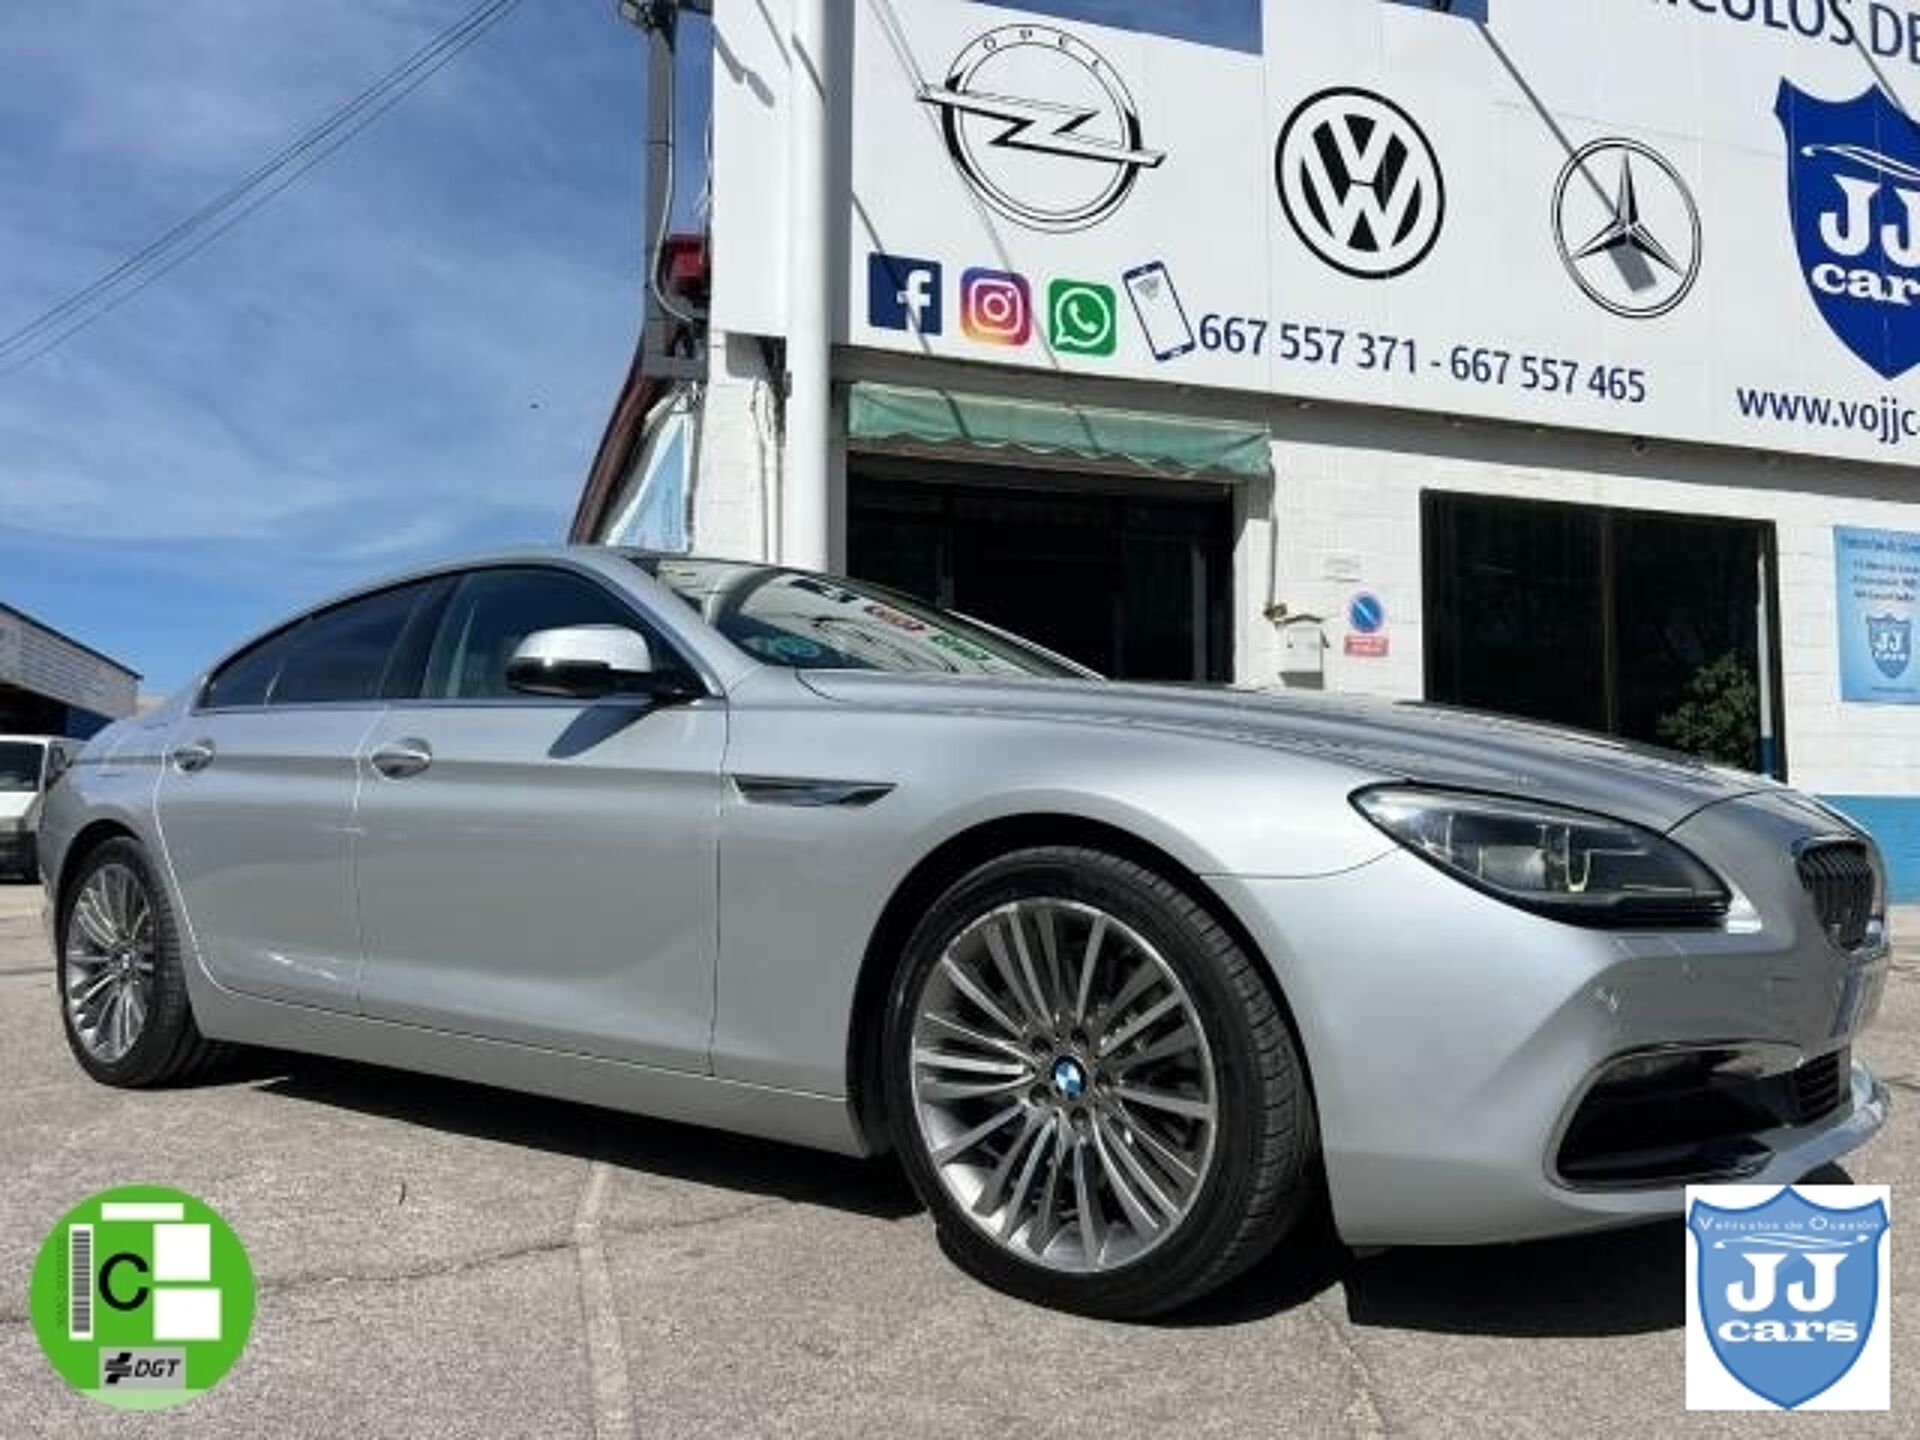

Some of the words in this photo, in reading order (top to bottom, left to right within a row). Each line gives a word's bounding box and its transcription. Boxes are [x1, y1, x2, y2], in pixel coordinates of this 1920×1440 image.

[1200, 314, 1267, 355] 667
[1280, 323, 1345, 365] 557
[1357, 332, 1417, 374] 371
[1450, 345, 1510, 386] 667
[1520, 355, 1579, 395] 557
[1587, 365, 1647, 403] 465
[1736, 387, 1920, 445] www.vojjc
